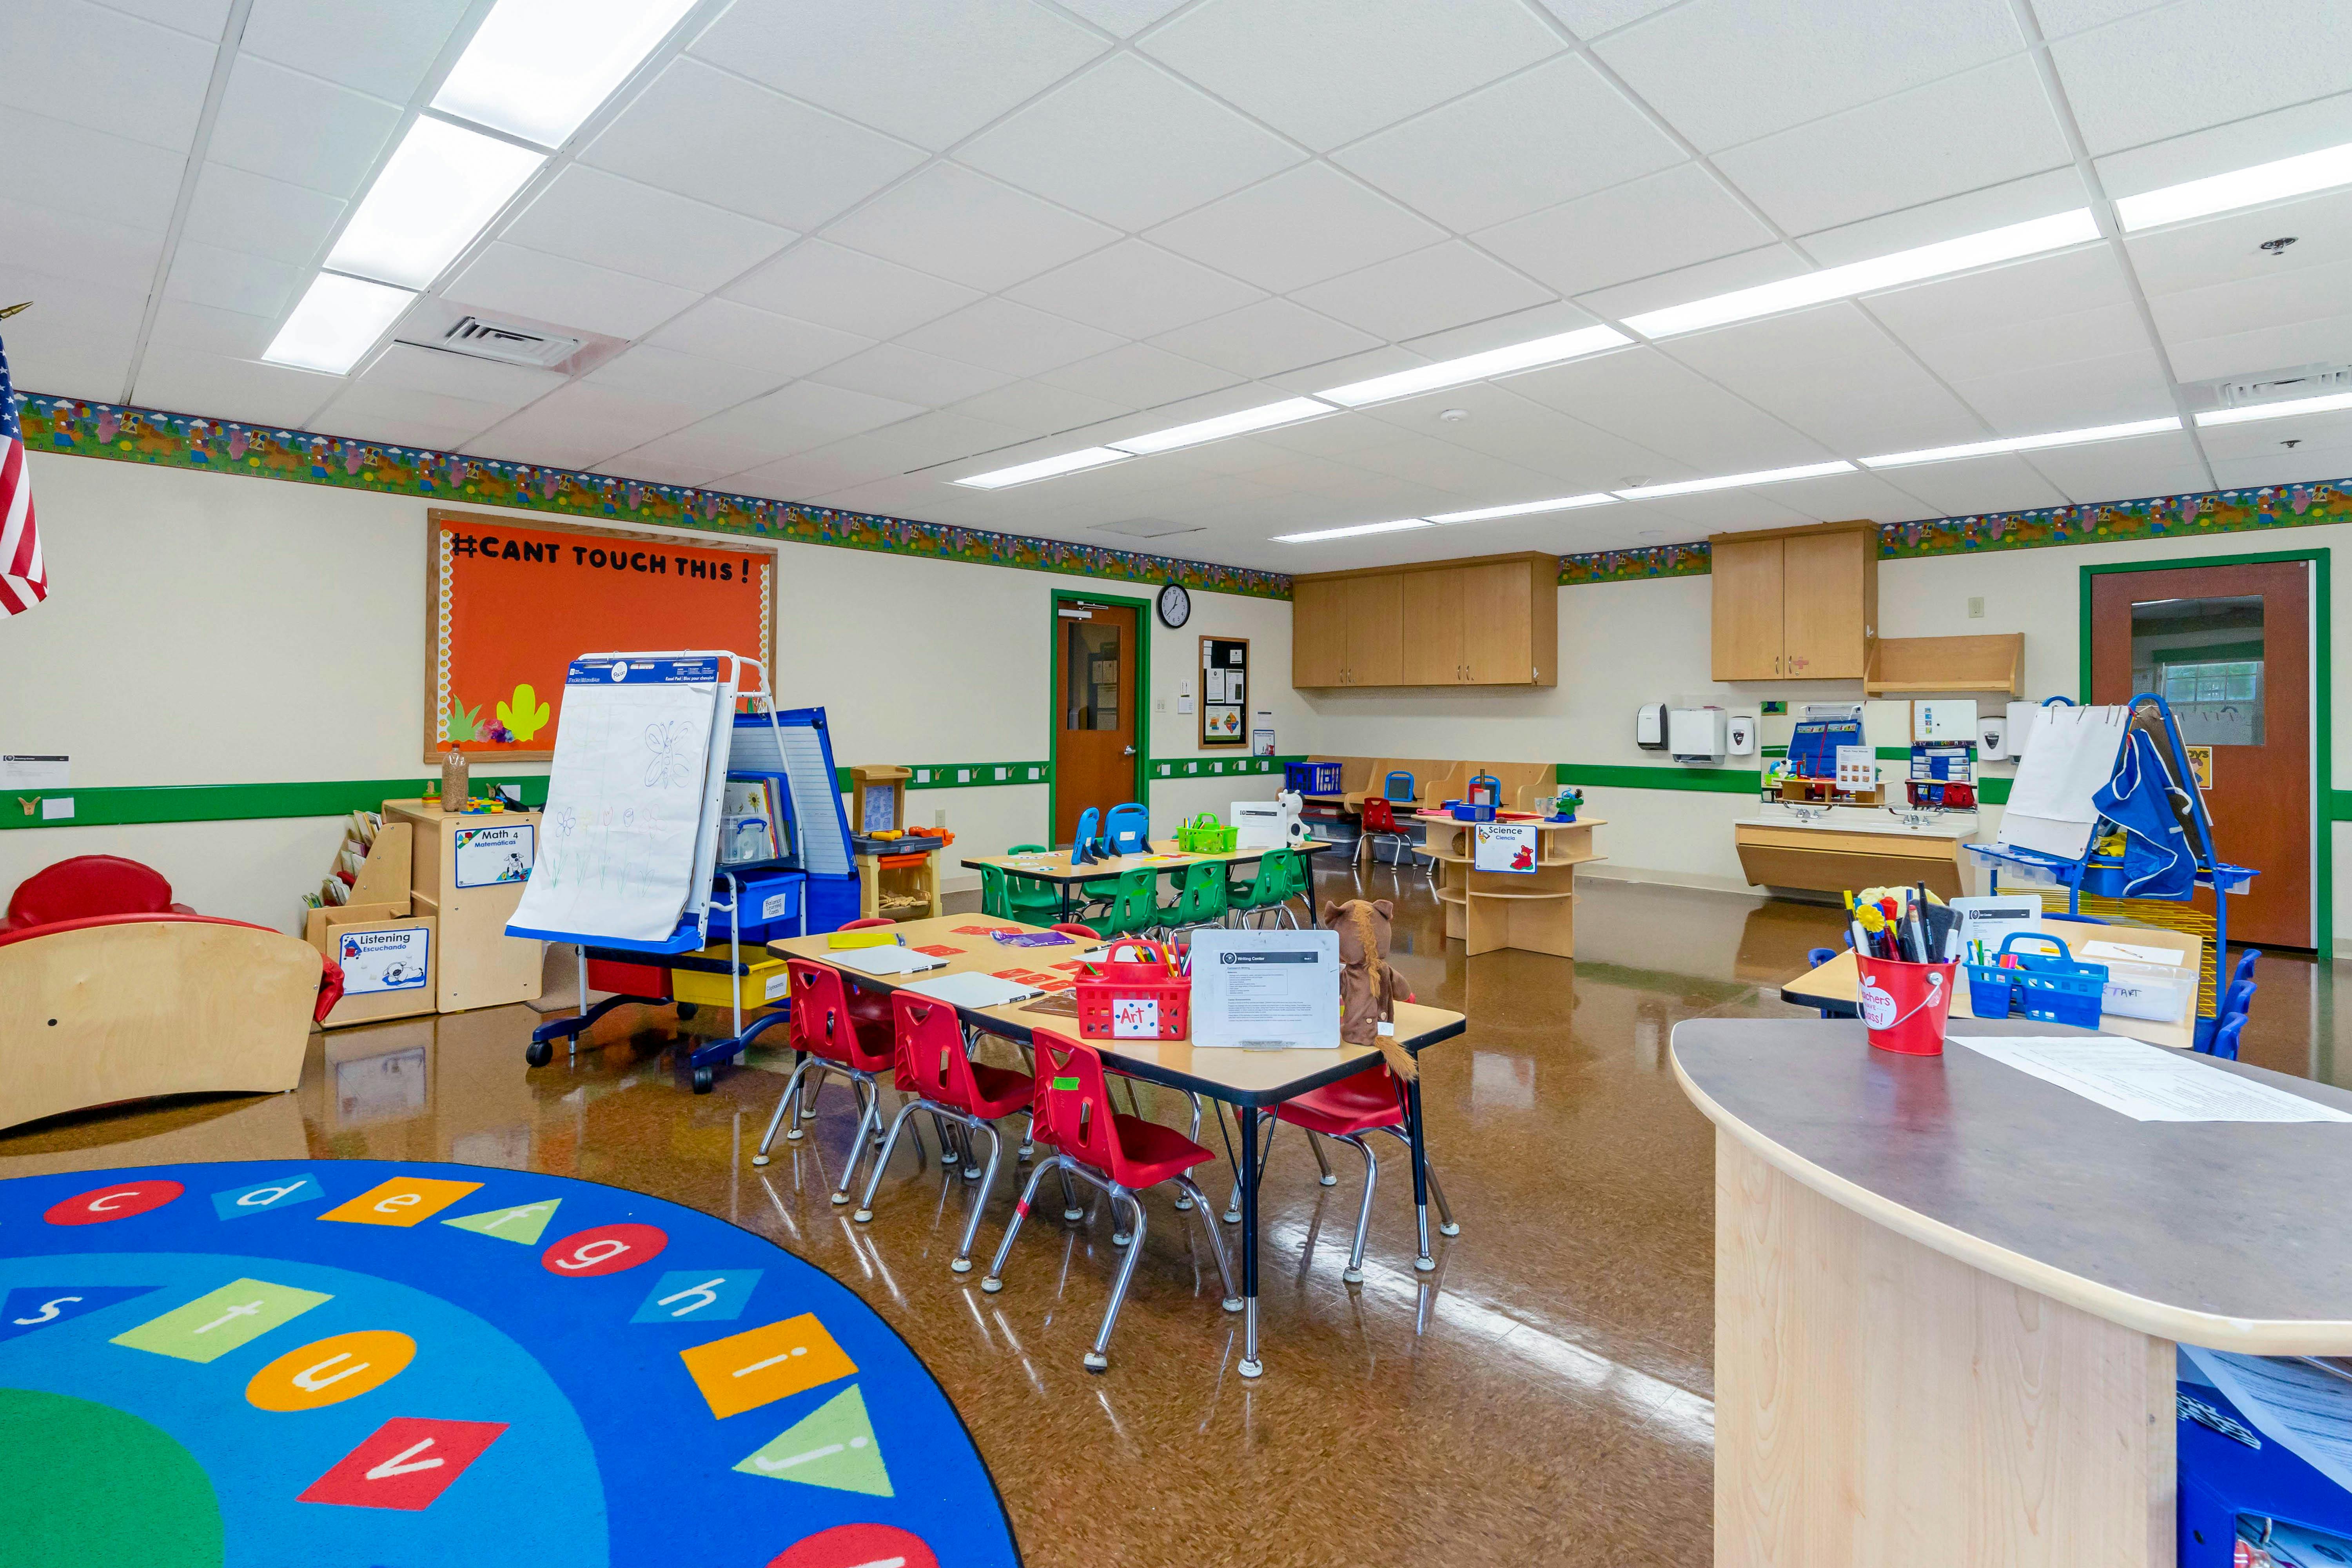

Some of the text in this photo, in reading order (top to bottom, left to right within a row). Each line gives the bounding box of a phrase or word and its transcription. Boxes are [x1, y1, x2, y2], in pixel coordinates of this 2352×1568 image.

[572, 546, 667, 575] TOUCH
[675, 557, 733, 581] THIS
[613, 670, 626, 679] Pacon
[482, 830, 508, 840] Math
[1488, 826, 1523, 834] Science
[474, 840, 516, 848] Matemáticas
[766, 898, 781, 907] Balance
[766, 902, 782, 911] Learning
[360, 933, 410, 945] Listening
[363, 944, 407, 952] Escuchando
[1862, 991, 1891, 1006] achers
[2121, 989, 2142, 998] ART
[1120, 1007, 1145, 1024] Art
[88, 1191, 140, 1212] c
[237, 1180, 307, 1206] d
[374, 1193, 421, 1214] e
[484, 1204, 549, 1231] f
[555, 1240, 631, 1270] g
[657, 1278, 726, 1317] h
[13, 1296, 83, 1326] s
[193, 1300, 264, 1334] t
[292, 1352, 370, 1392] u
[732, 1346, 808, 1378] i
[366, 1437, 445, 1481] v
[753, 1434, 870, 1472] j
